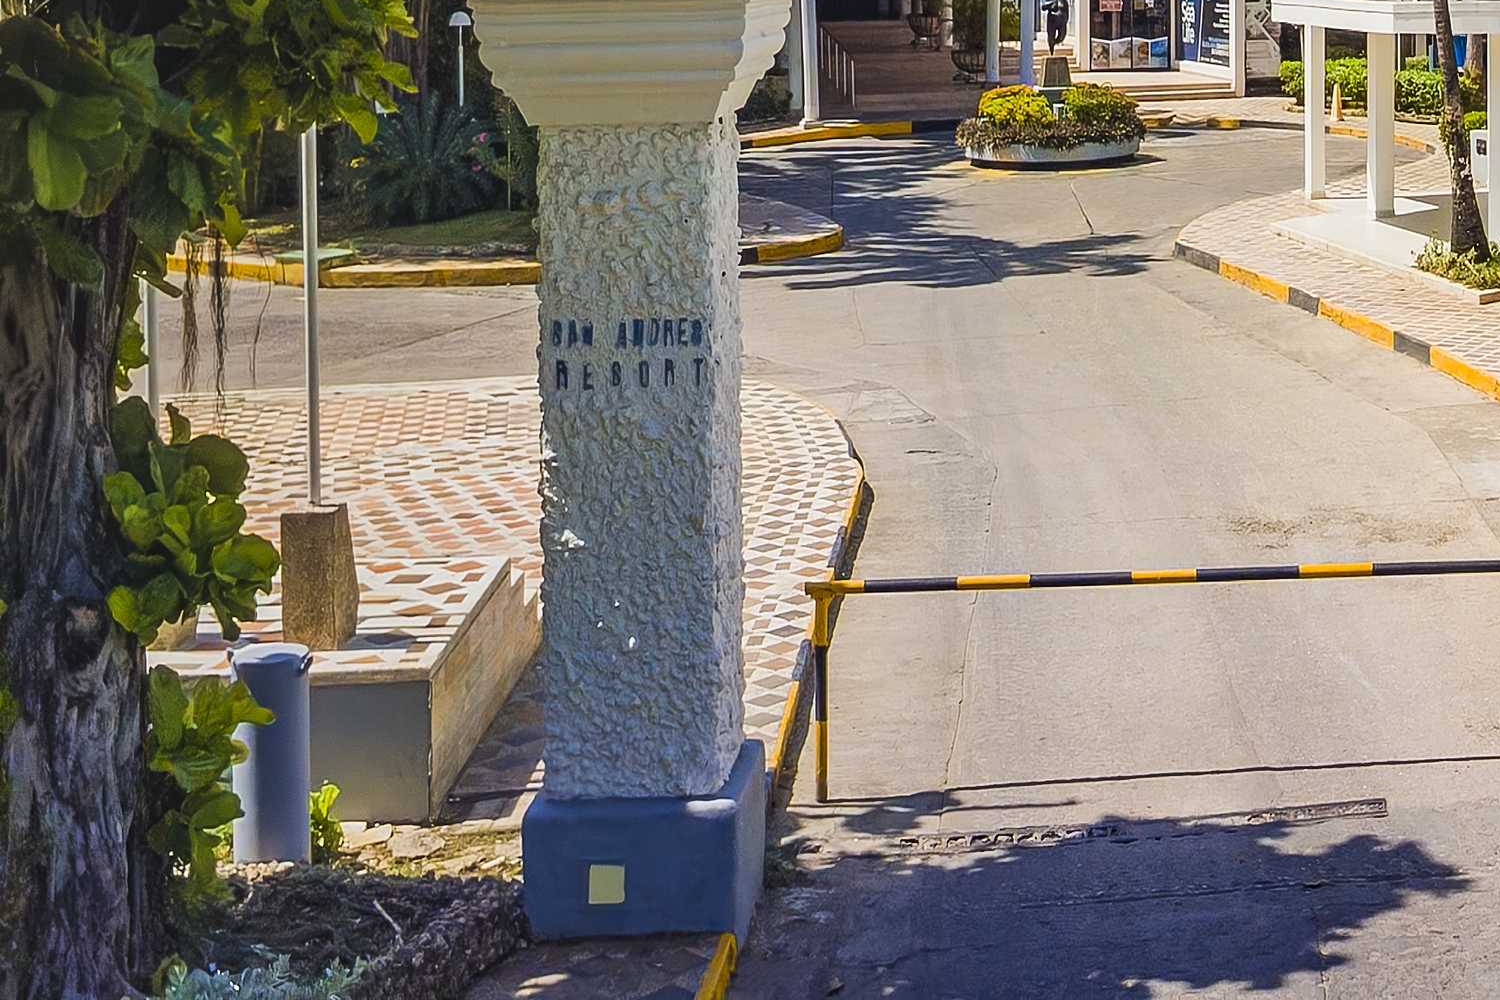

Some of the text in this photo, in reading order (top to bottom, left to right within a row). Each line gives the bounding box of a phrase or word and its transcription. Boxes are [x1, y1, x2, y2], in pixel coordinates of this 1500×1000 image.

[552, 317, 703, 349] SAN ANDRES
[555, 357, 704, 390] RESORT
